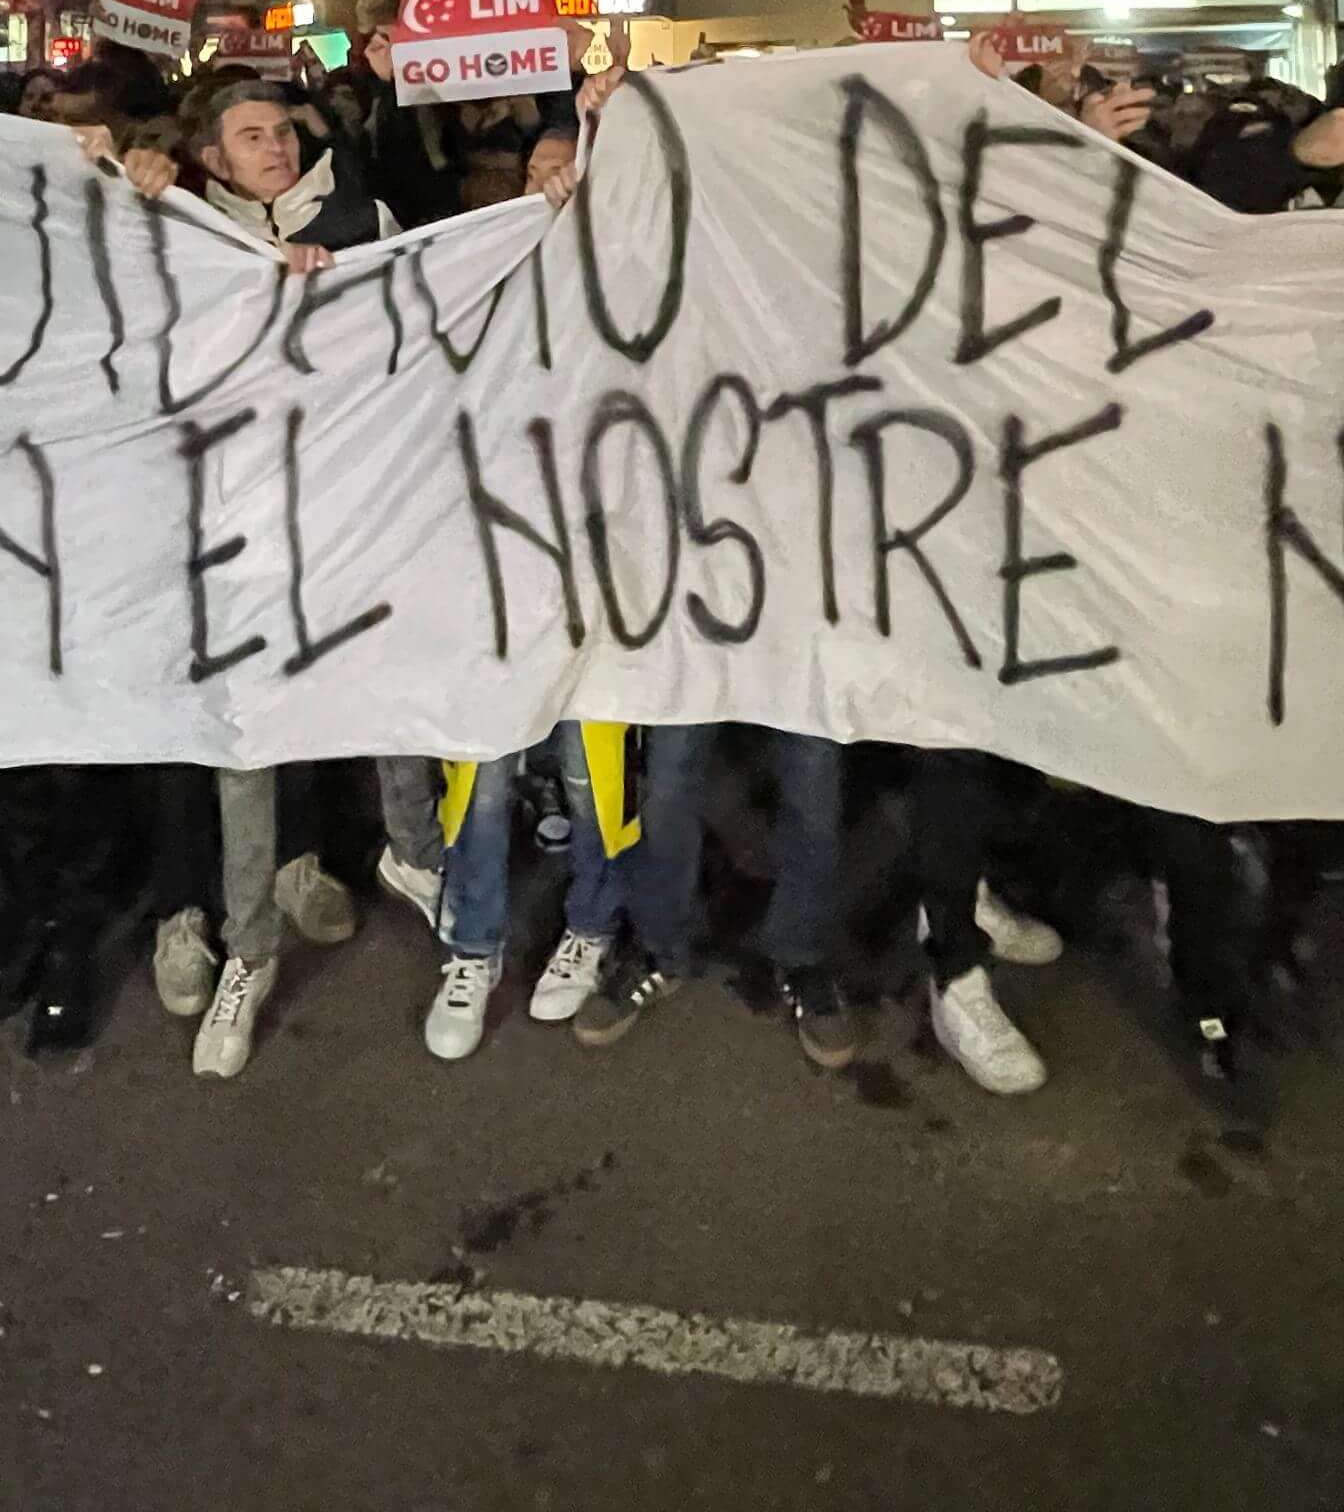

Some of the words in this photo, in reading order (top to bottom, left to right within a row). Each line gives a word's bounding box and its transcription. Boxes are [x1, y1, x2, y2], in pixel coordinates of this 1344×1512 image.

[891, 20, 938, 38] LIM
[1016, 35, 1064, 54] LIM
[401, 57, 451, 85] GO
[838, 73, 1215, 373] DEL
[178, 405, 392, 684] EL
[454, 372, 1122, 686] NOSTRE
